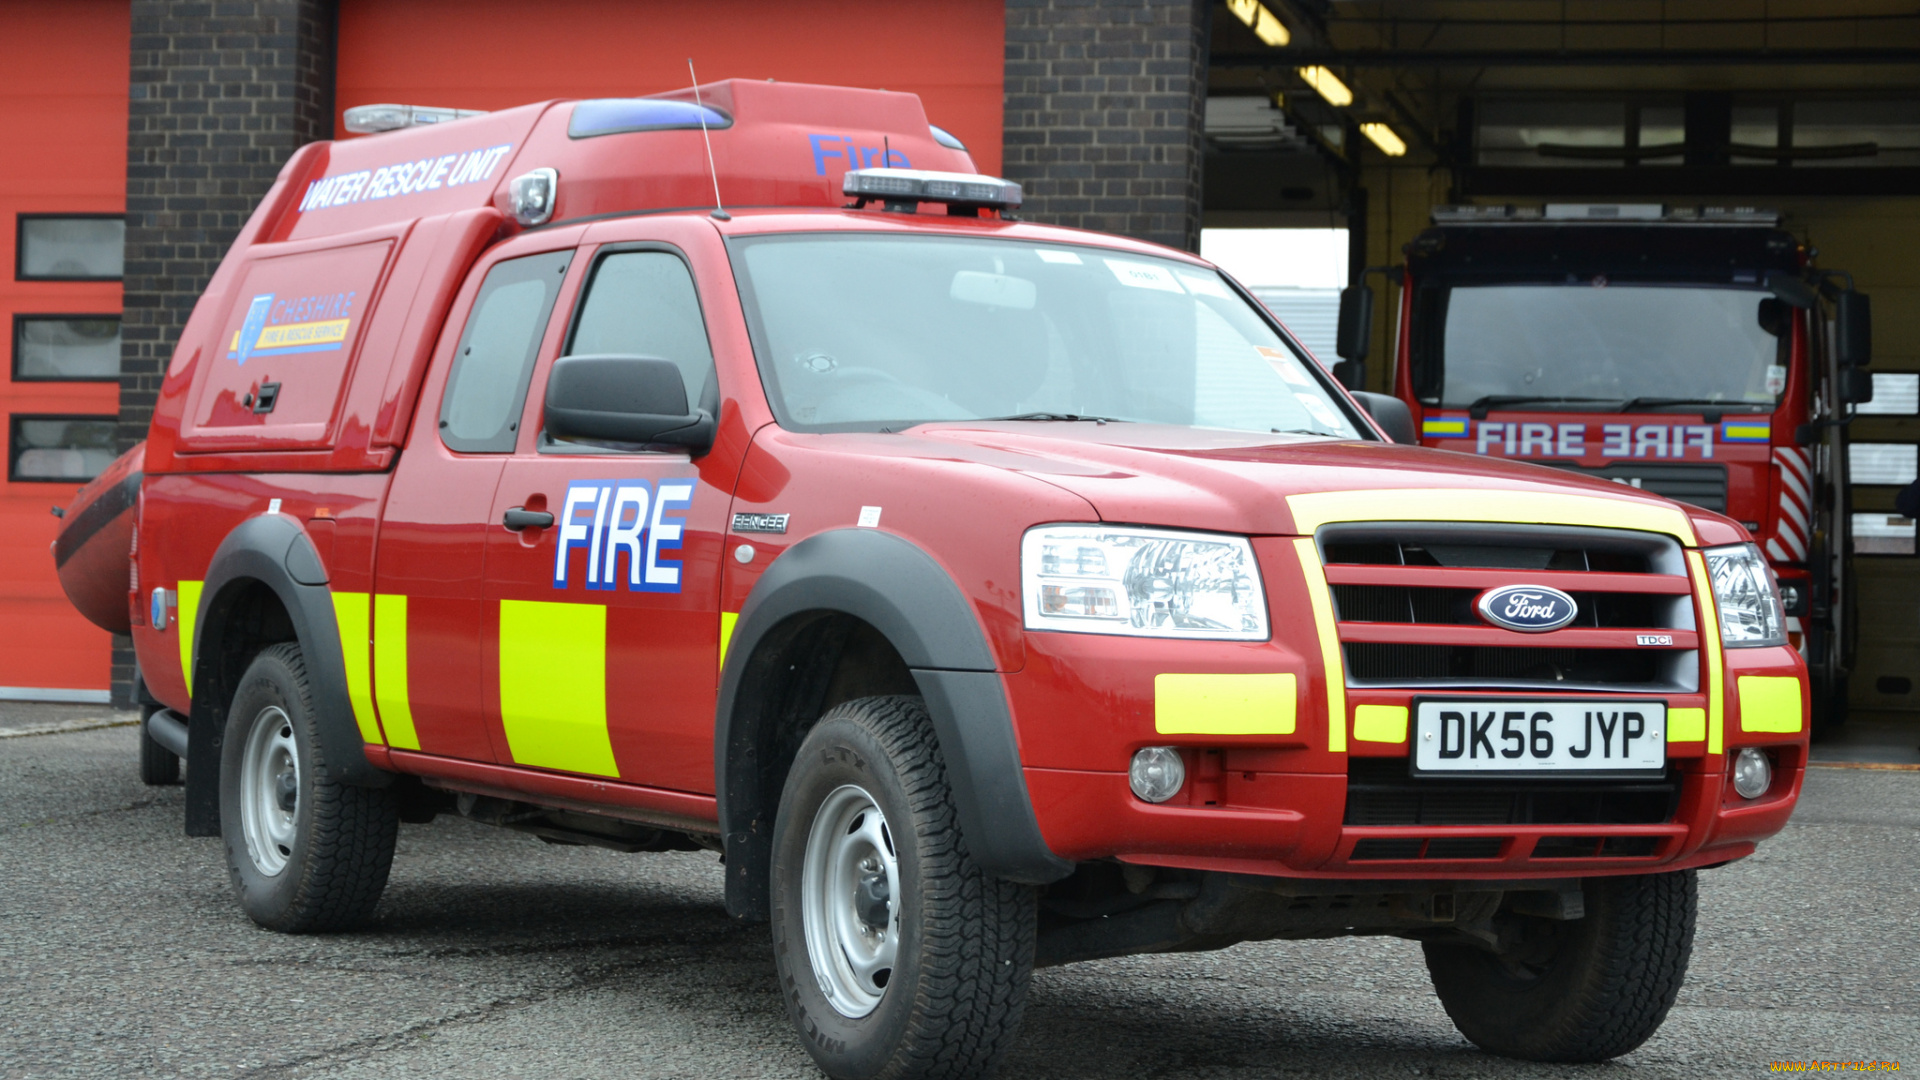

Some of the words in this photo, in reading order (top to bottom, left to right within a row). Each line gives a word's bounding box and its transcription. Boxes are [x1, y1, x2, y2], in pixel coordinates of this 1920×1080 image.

[808, 134, 912, 175] Fire
[298, 168, 372, 212] WATER
[361, 154, 457, 202] RESCUE
[446, 143, 513, 187] UNIT
[272, 291, 356, 323] CHESHIRE
[264, 330, 282, 343] FIRE
[286, 326, 315, 341] RESCUE
[313, 323, 344, 339] SERVICE
[1477, 422, 1587, 457] FIRE
[553, 478, 697, 593] FIRE
[732, 514, 786, 530] RANGER
[1504, 592, 1556, 620] Ford
[1639, 635, 1673, 646] TDCi
[1439, 711, 1554, 759] DK56
[1568, 711, 1645, 759] JYP
[820, 742, 867, 773] LTX
